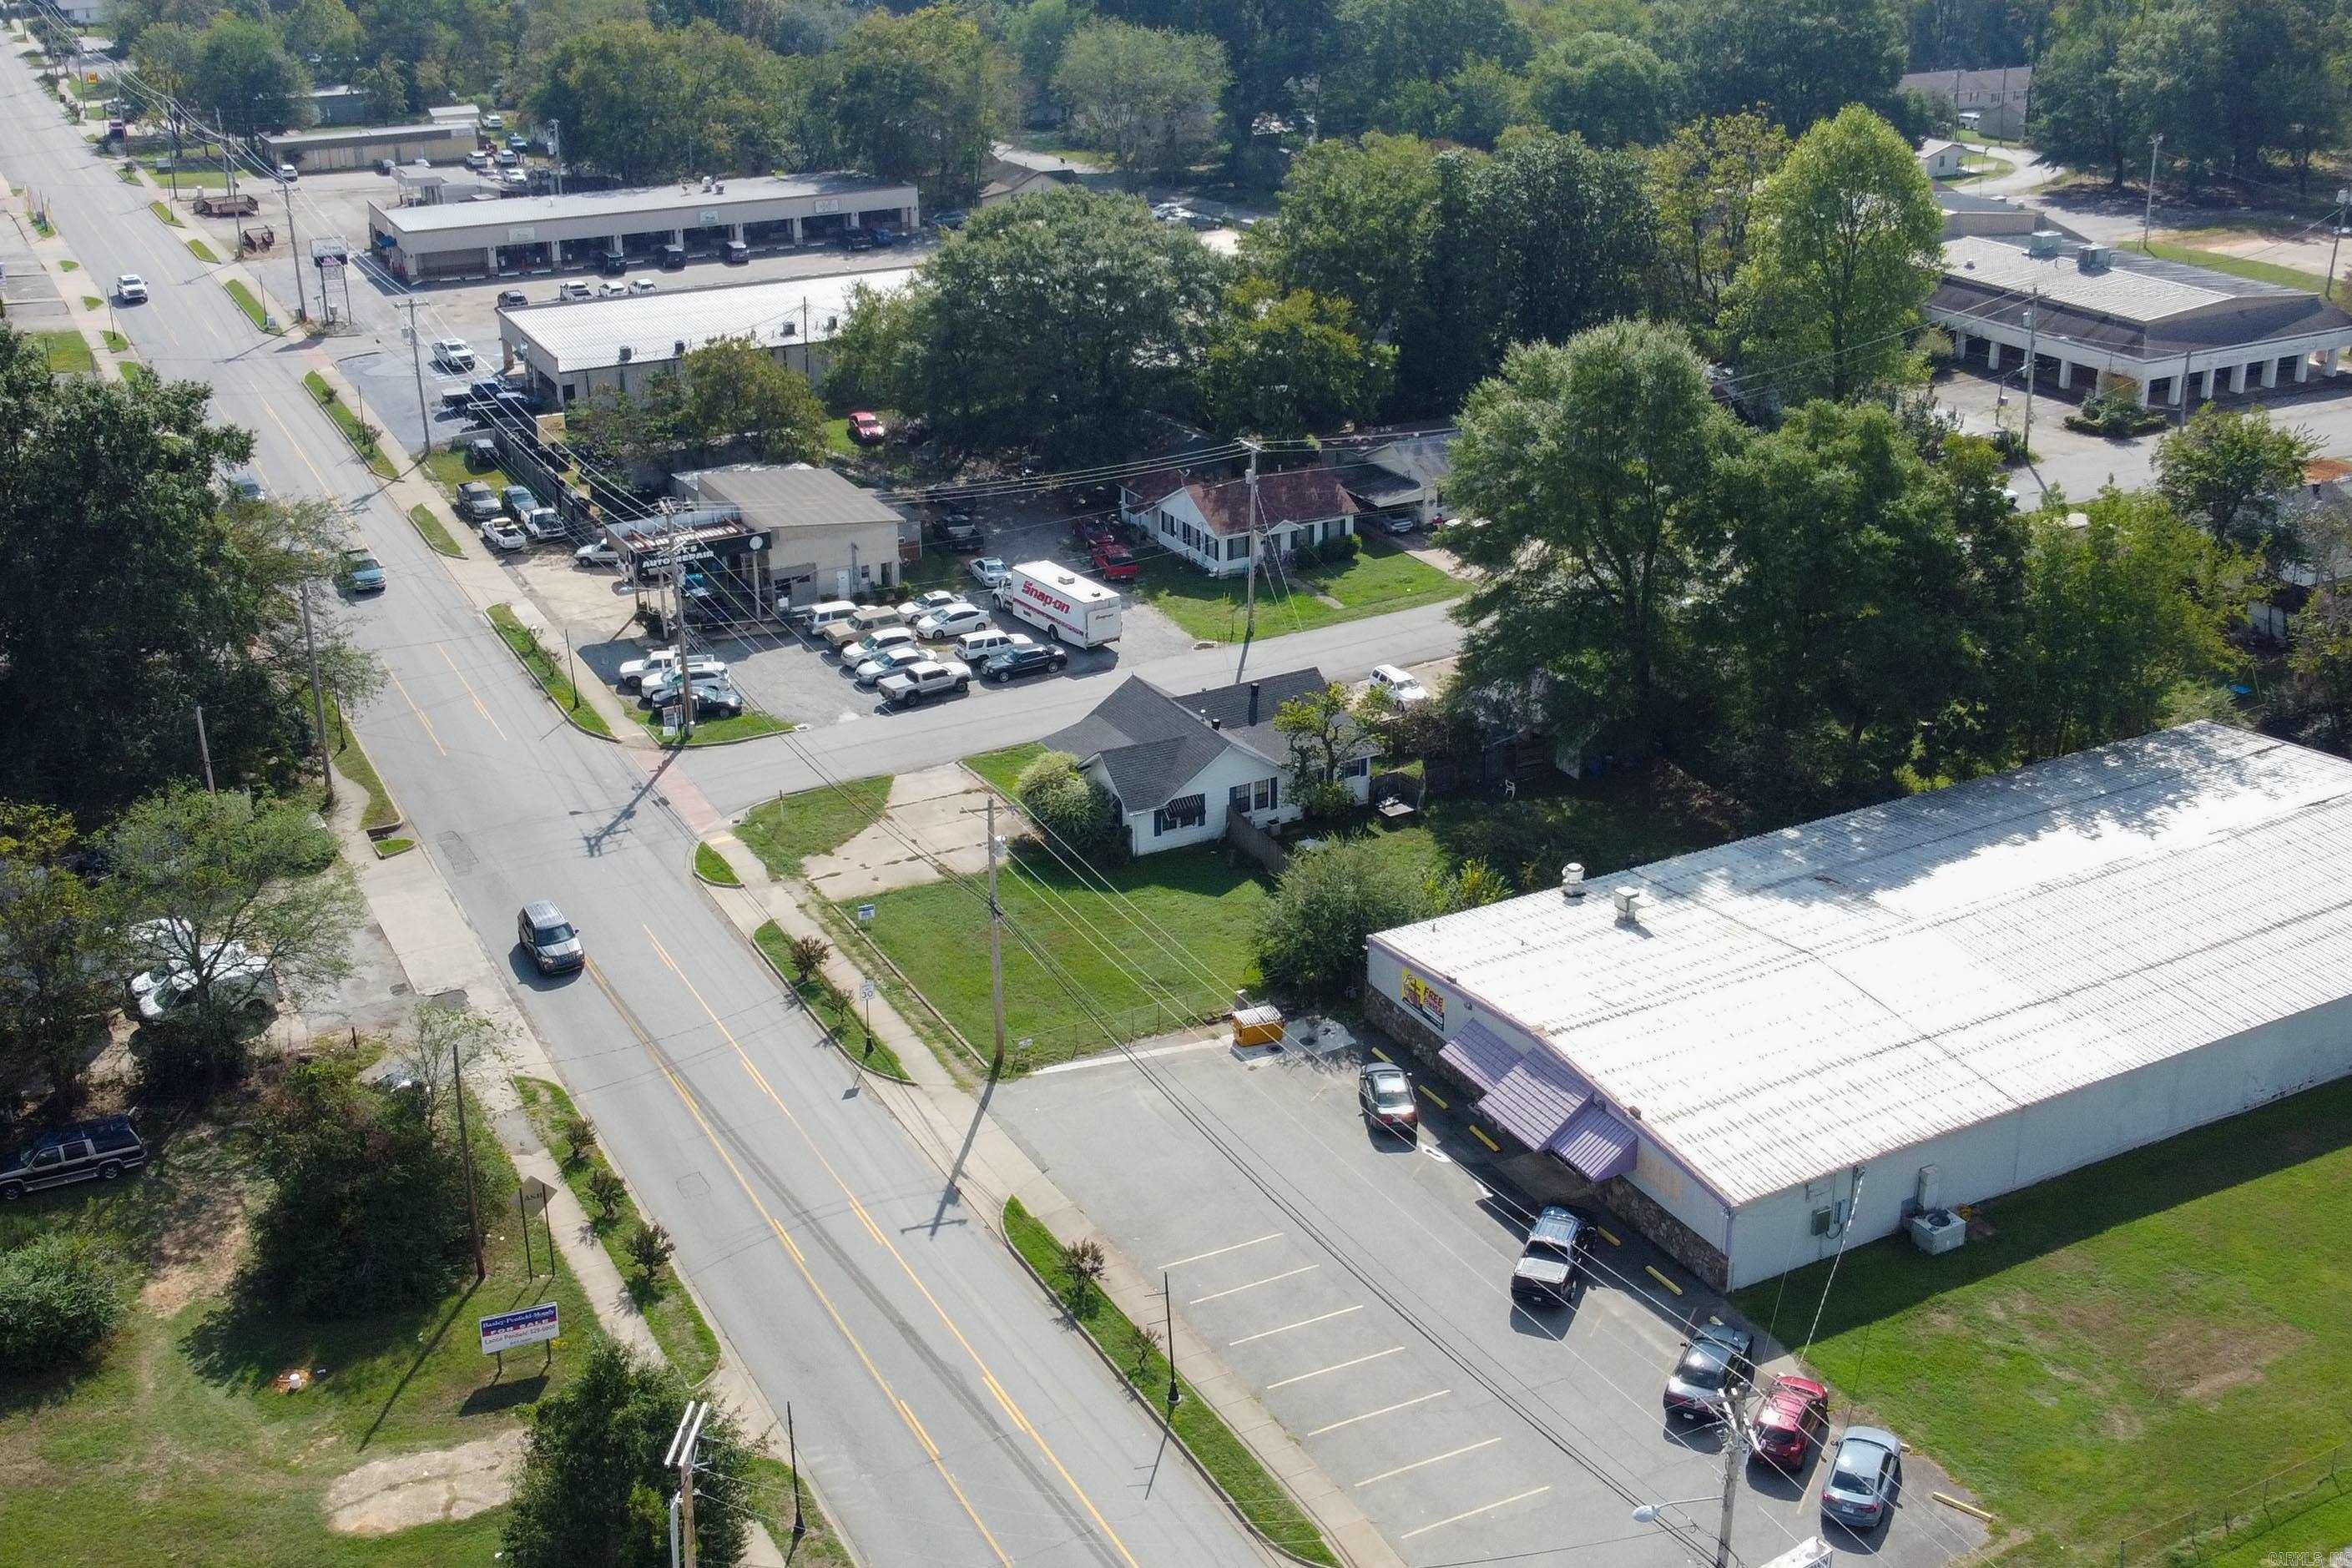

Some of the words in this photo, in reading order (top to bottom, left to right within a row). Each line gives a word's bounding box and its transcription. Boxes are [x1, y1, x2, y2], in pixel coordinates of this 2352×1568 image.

[642, 557, 671, 568] AUTO
[675, 550, 714, 563] REPAIR
[1021, 580, 1071, 614] Snap-on
[861, 990, 874, 999] 30
[1424, 986, 1444, 1007] FREE
[490, 1326, 514, 1335] FOR
[519, 1318, 549, 1329] SALE
